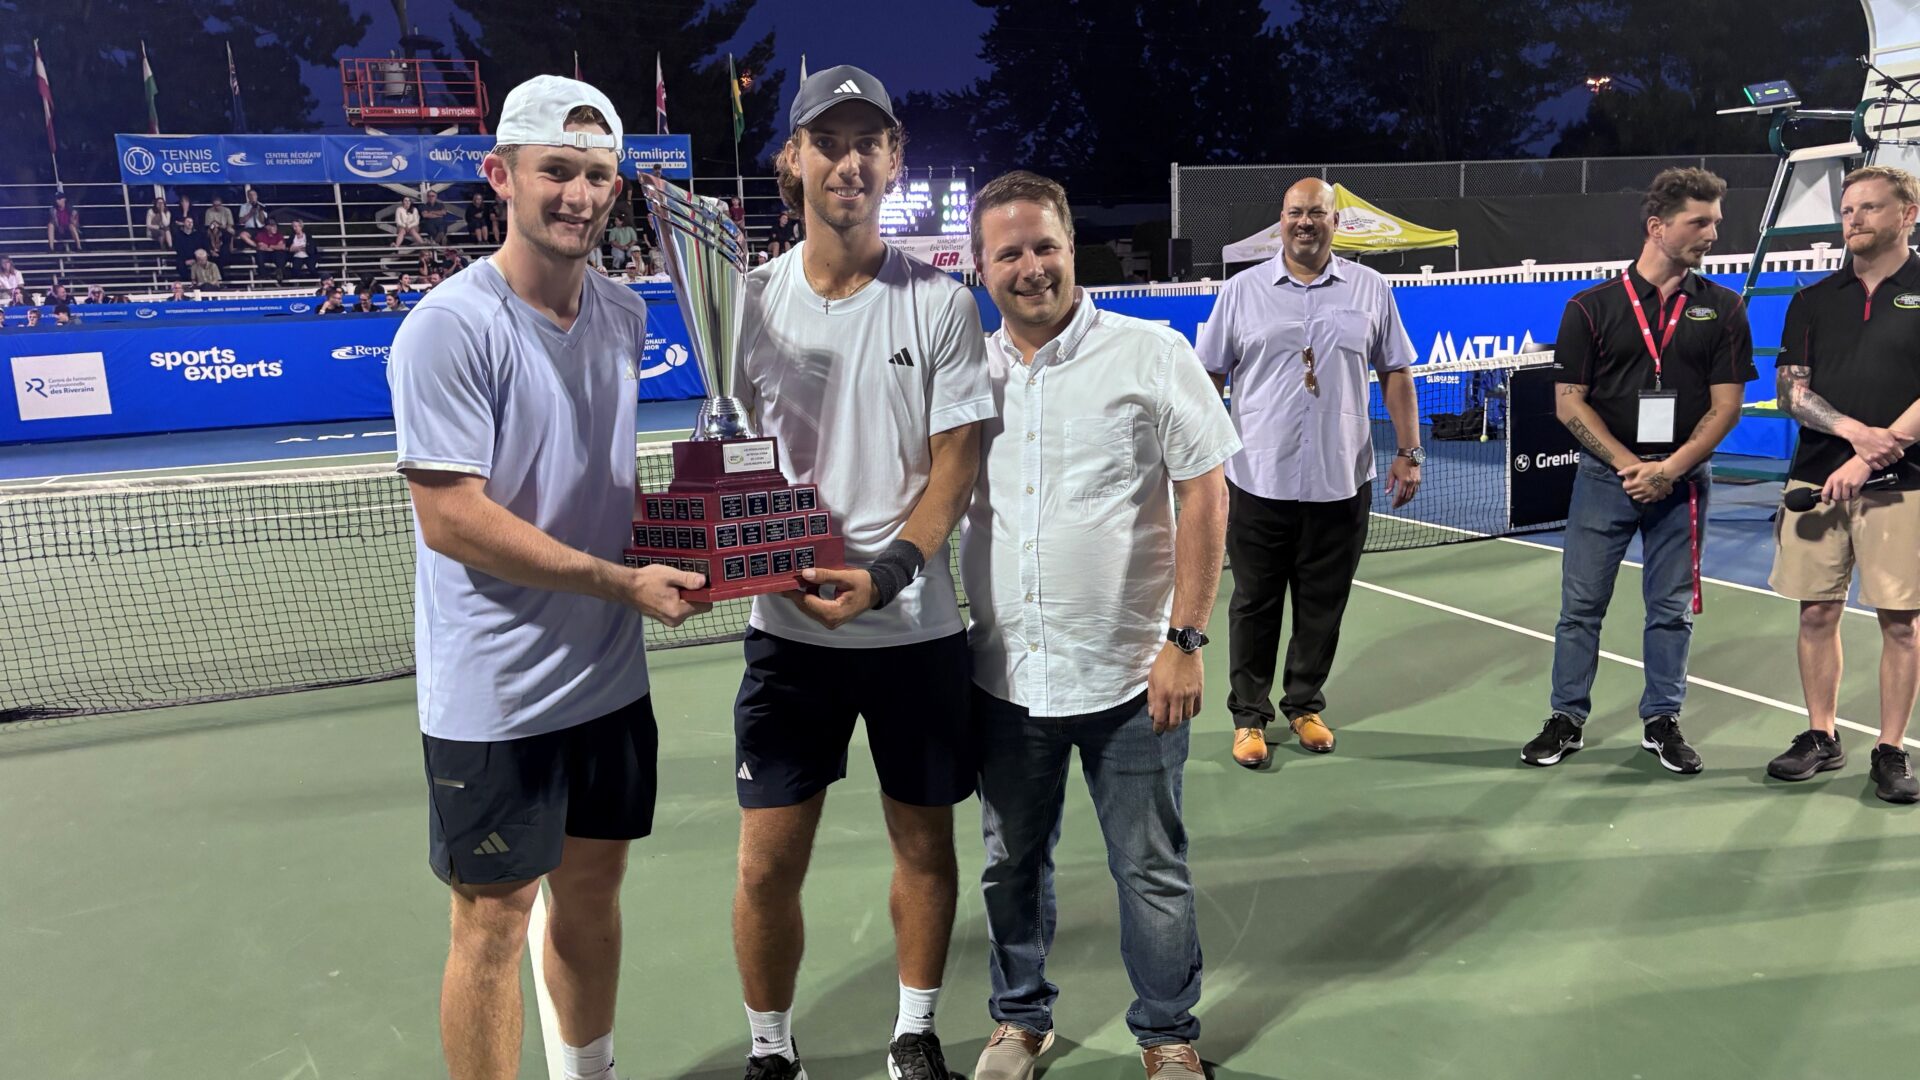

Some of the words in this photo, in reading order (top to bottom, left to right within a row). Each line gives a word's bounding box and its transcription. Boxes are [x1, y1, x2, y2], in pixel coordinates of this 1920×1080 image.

[441, 107, 475, 116] simplex
[159, 149, 212, 161] TENNIS
[429, 148, 452, 161] club
[628, 147, 686, 162] familiprix
[161, 160, 221, 176] QUÉBEC
[932, 252, 960, 267] IGA
[150, 346, 236, 371] sports
[184, 360, 283, 384] experts
[63, 387, 95, 395] Riverains
